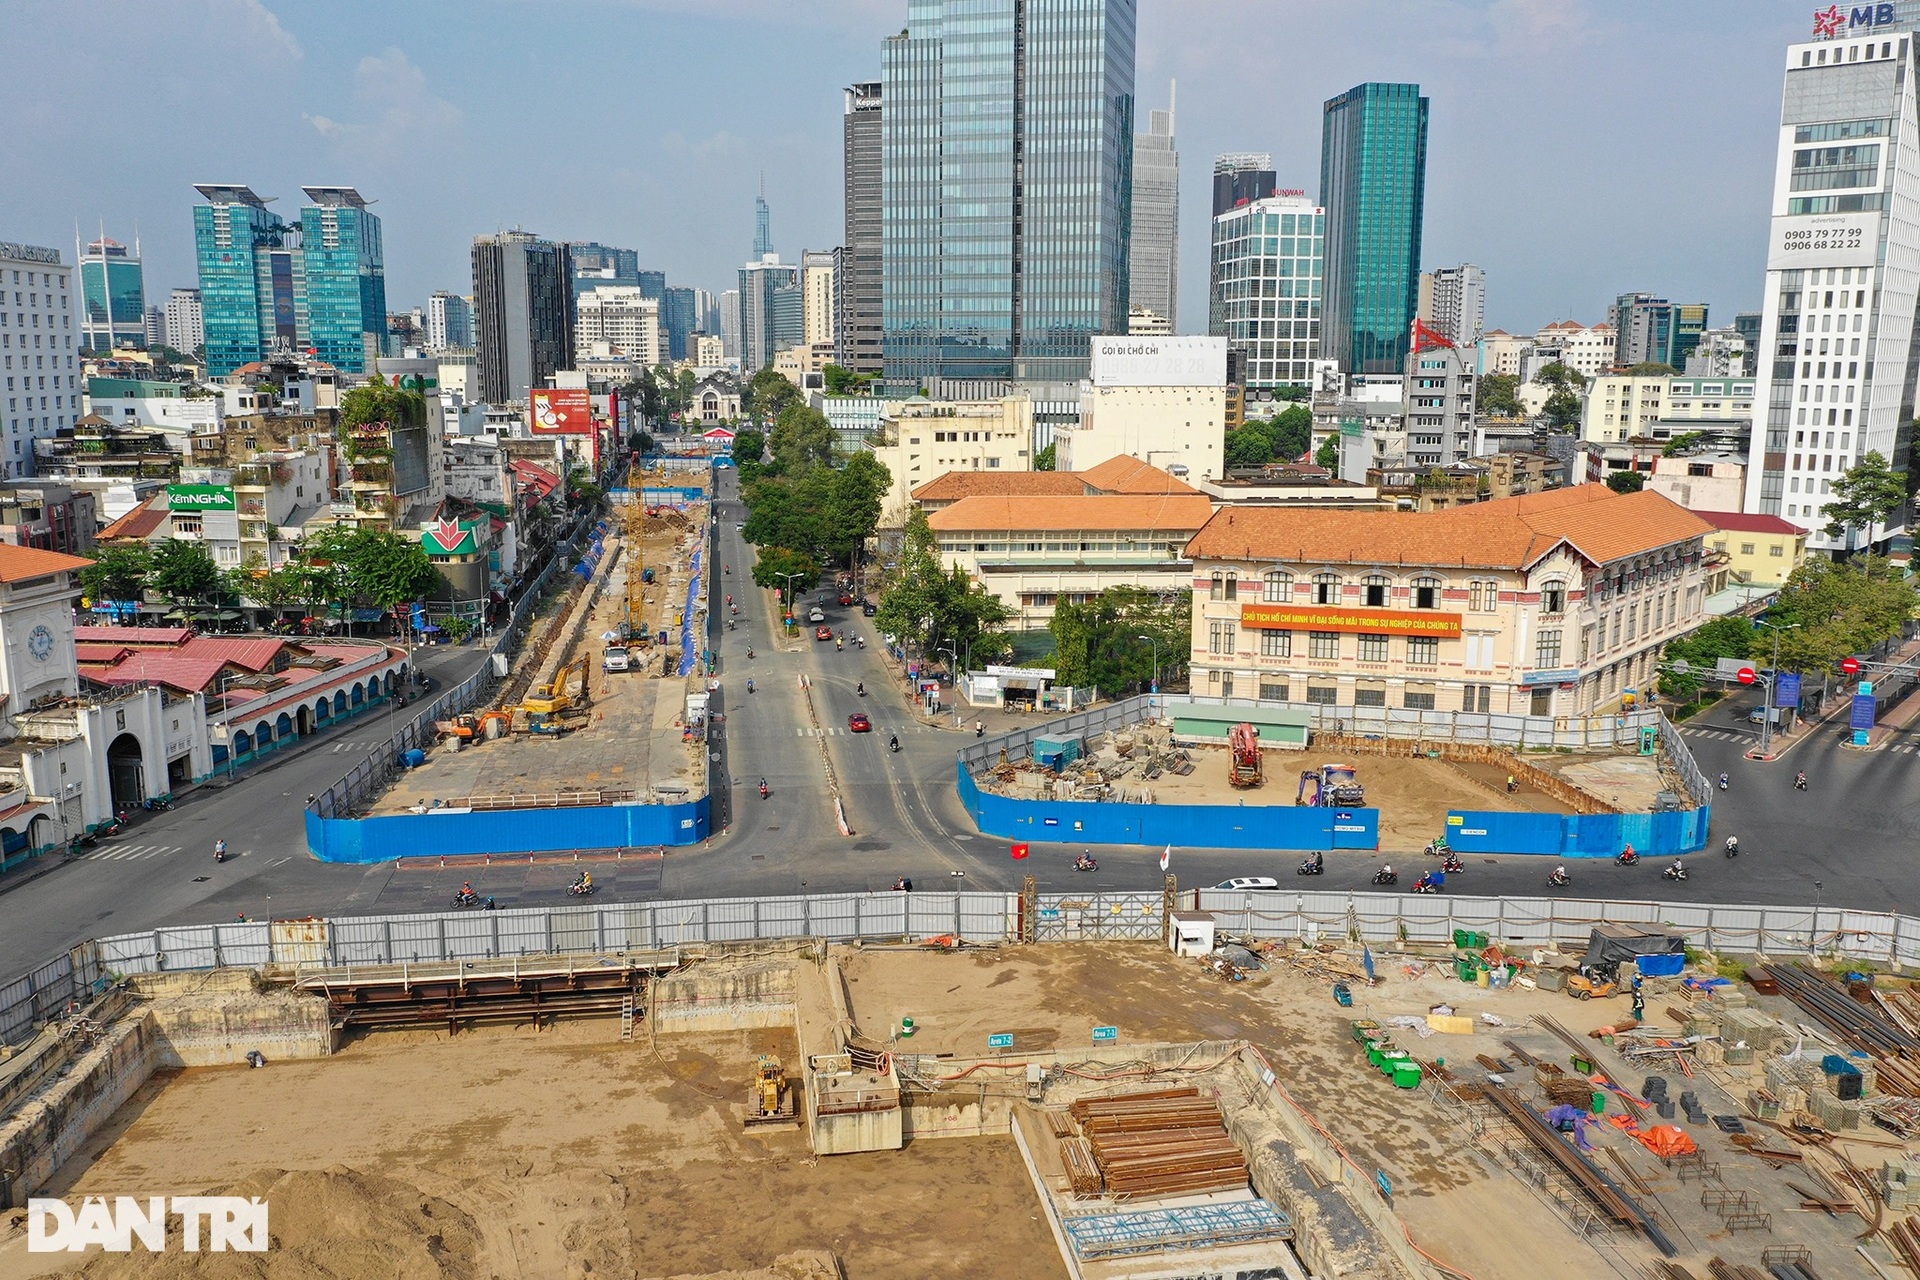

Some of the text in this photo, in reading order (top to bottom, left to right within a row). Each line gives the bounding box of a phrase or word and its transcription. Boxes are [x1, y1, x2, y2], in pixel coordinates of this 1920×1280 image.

[1849, 4, 1894, 28] MB
[1785, 228, 1862, 240] 0903 79 77 99
[1784, 239, 1861, 251] 0906 68 22 22
[1102, 347, 1115, 356] GỌI
[1118, 347, 1126, 355] ĐI
[1145, 347, 1159, 355] CHI
[1243, 611, 1458, 630] CHỦ TỊCH HỒ CHÍ MINH VĨ ĐẠI SỐNG MÃI TRONG SỰ NGHIỆP CỦA CHÚNG TA
[1003, 1036, 1012, 1044] 7-2
